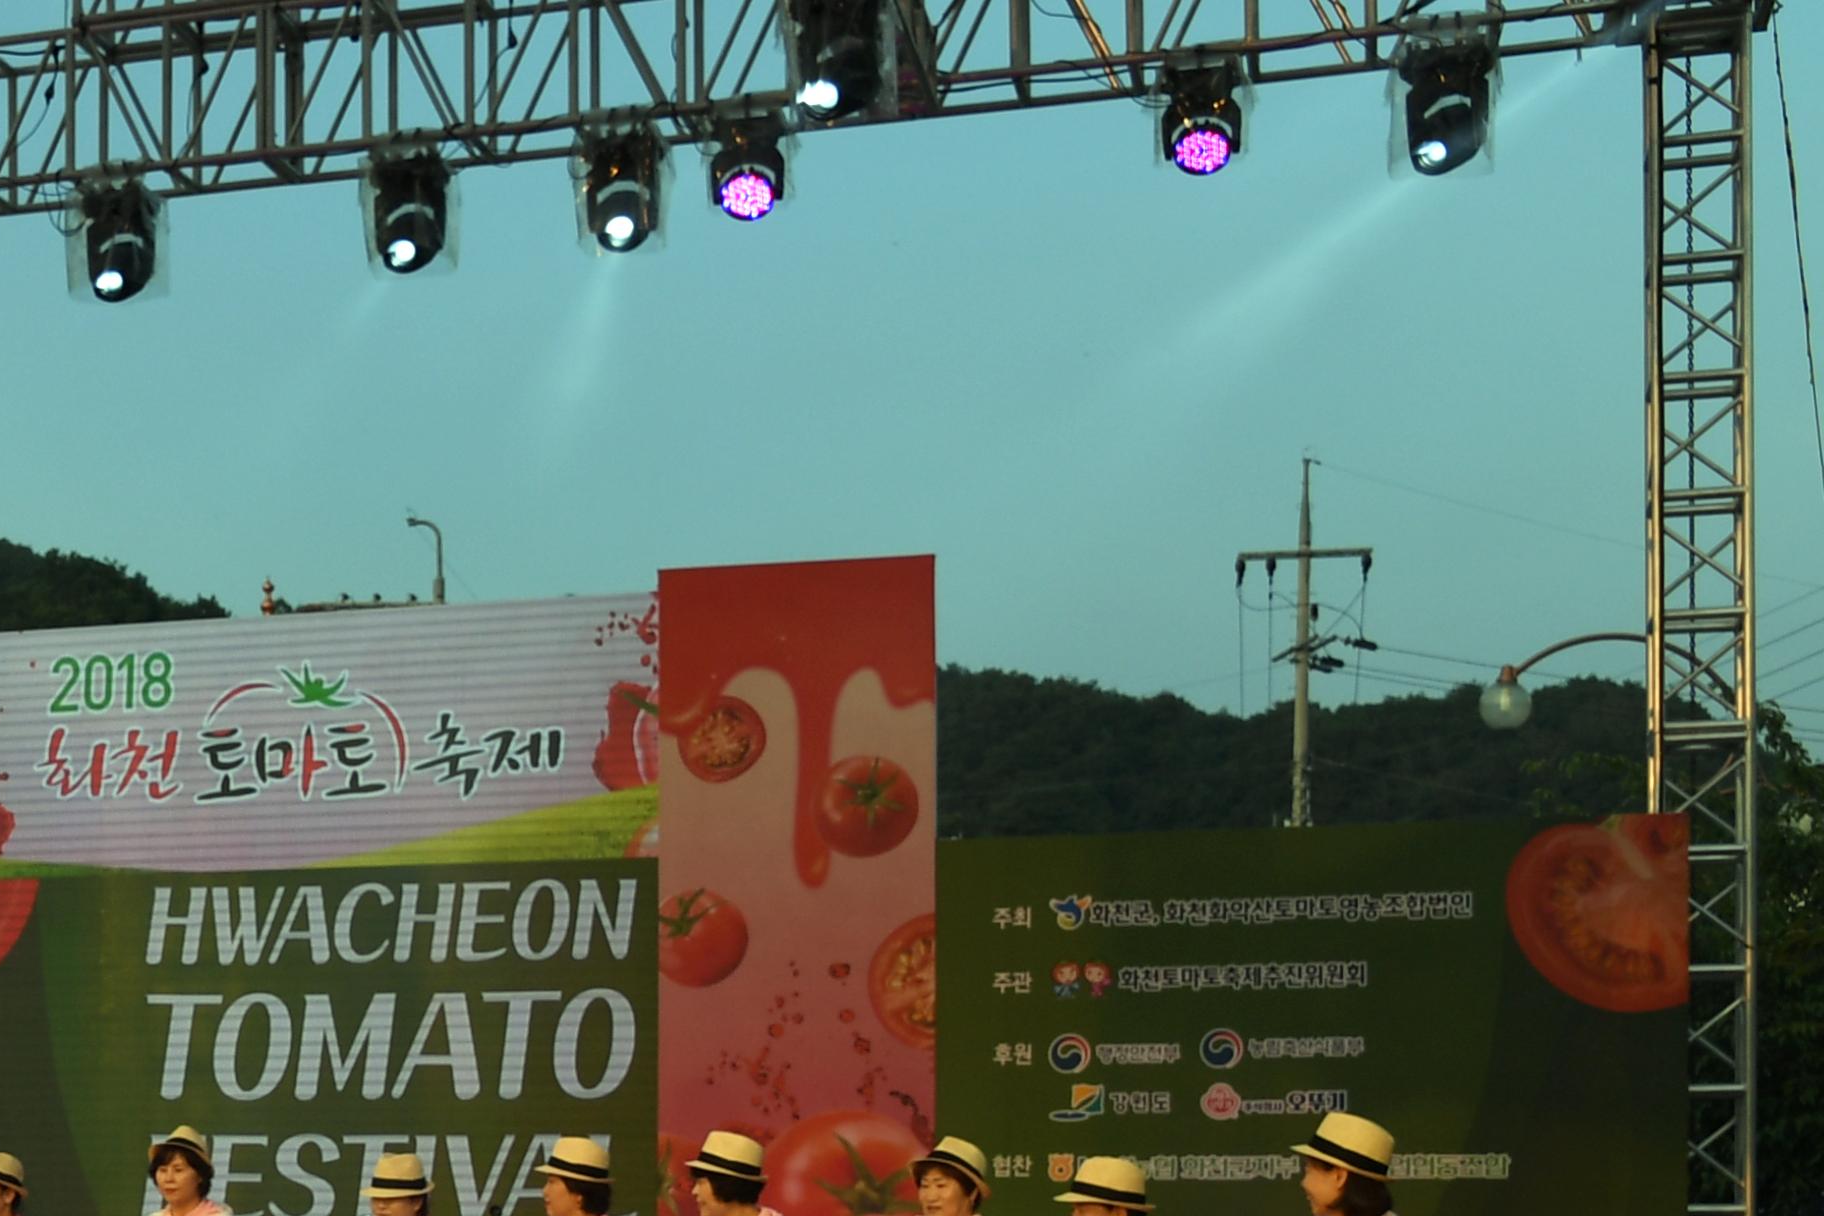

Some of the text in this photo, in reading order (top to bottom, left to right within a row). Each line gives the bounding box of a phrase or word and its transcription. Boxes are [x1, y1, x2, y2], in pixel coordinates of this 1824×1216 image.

[49, 652, 174, 714] 2018
[38, 712, 564, 800] 화천 토마토 축제
[145, 876, 638, 967] HWACHEON
[992, 905, 1032, 929] 주최
[992, 972, 1033, 995] 주관
[1118, 960, 1368, 992] 화천토마토축제추진위원회
[145, 988, 638, 1103] TOMATO
[992, 1042, 1033, 1067] 후원
[992, 1154, 1033, 1178] 협찬
